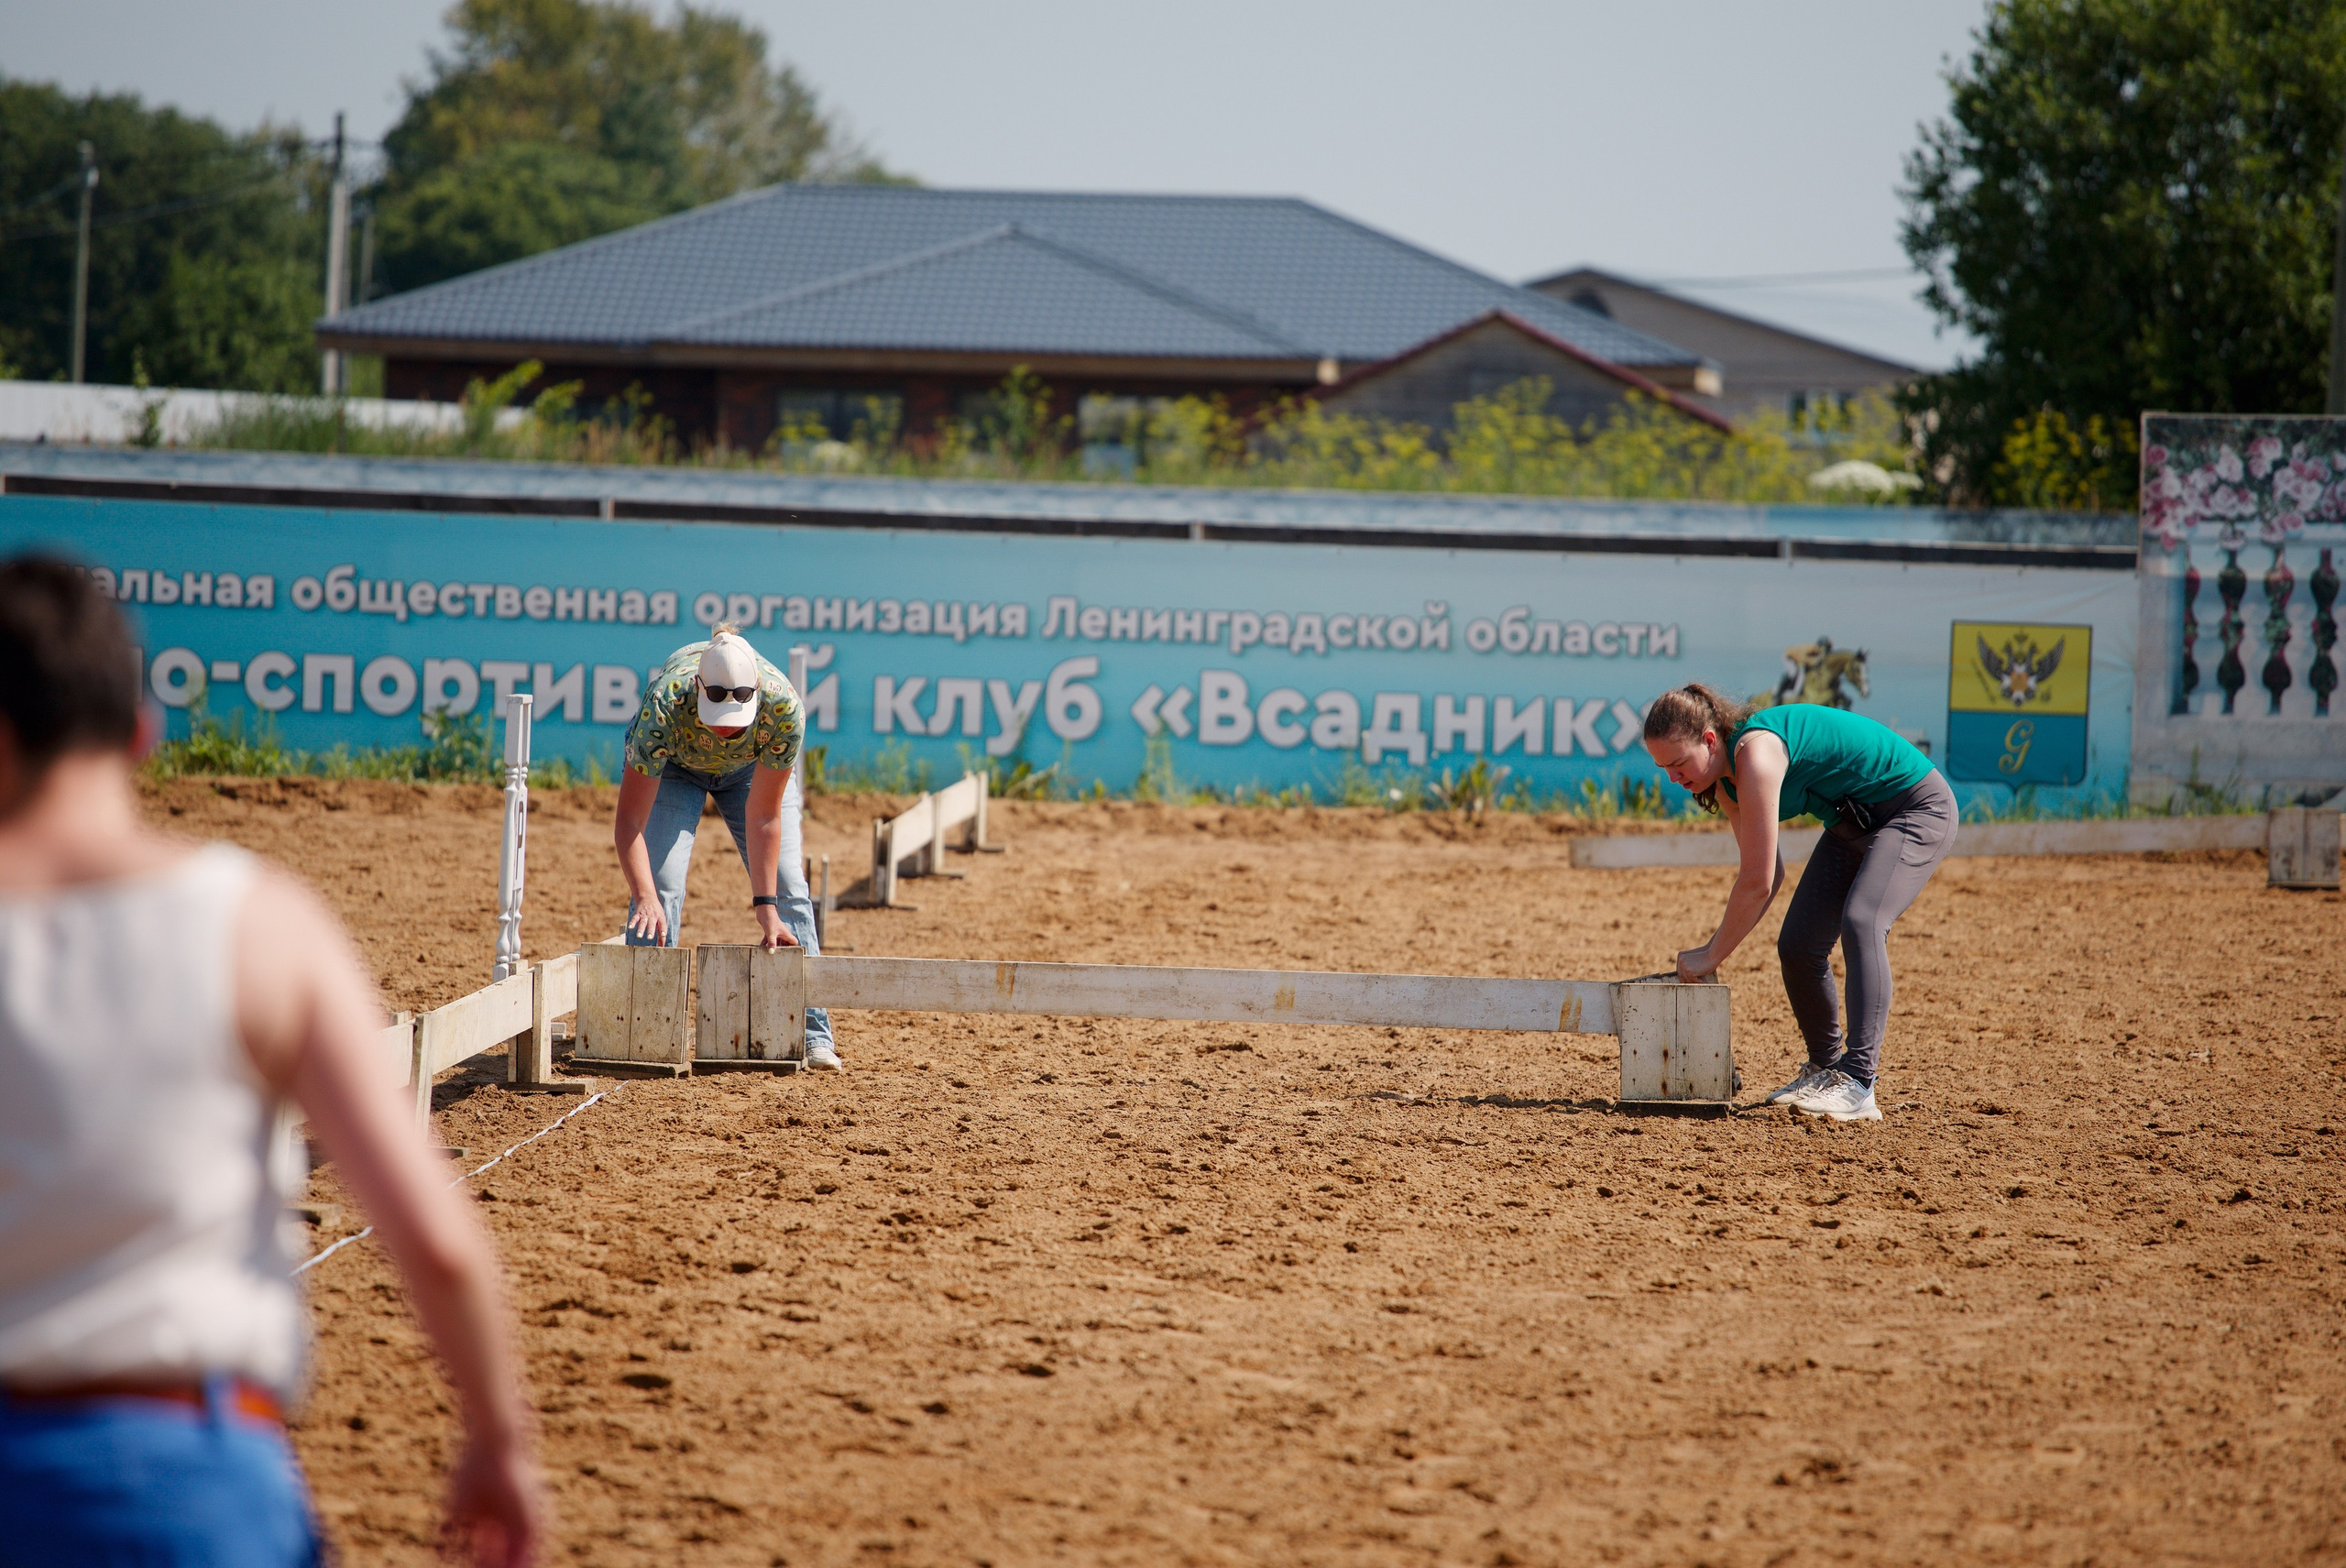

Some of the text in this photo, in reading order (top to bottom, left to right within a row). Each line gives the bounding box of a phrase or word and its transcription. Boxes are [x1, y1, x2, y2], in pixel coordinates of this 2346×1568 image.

[57, 564, 1679, 657] альная общественная организация Ленинградской области
[131, 643, 839, 735] о-спортивй
[873, 656, 1102, 756] клуб
